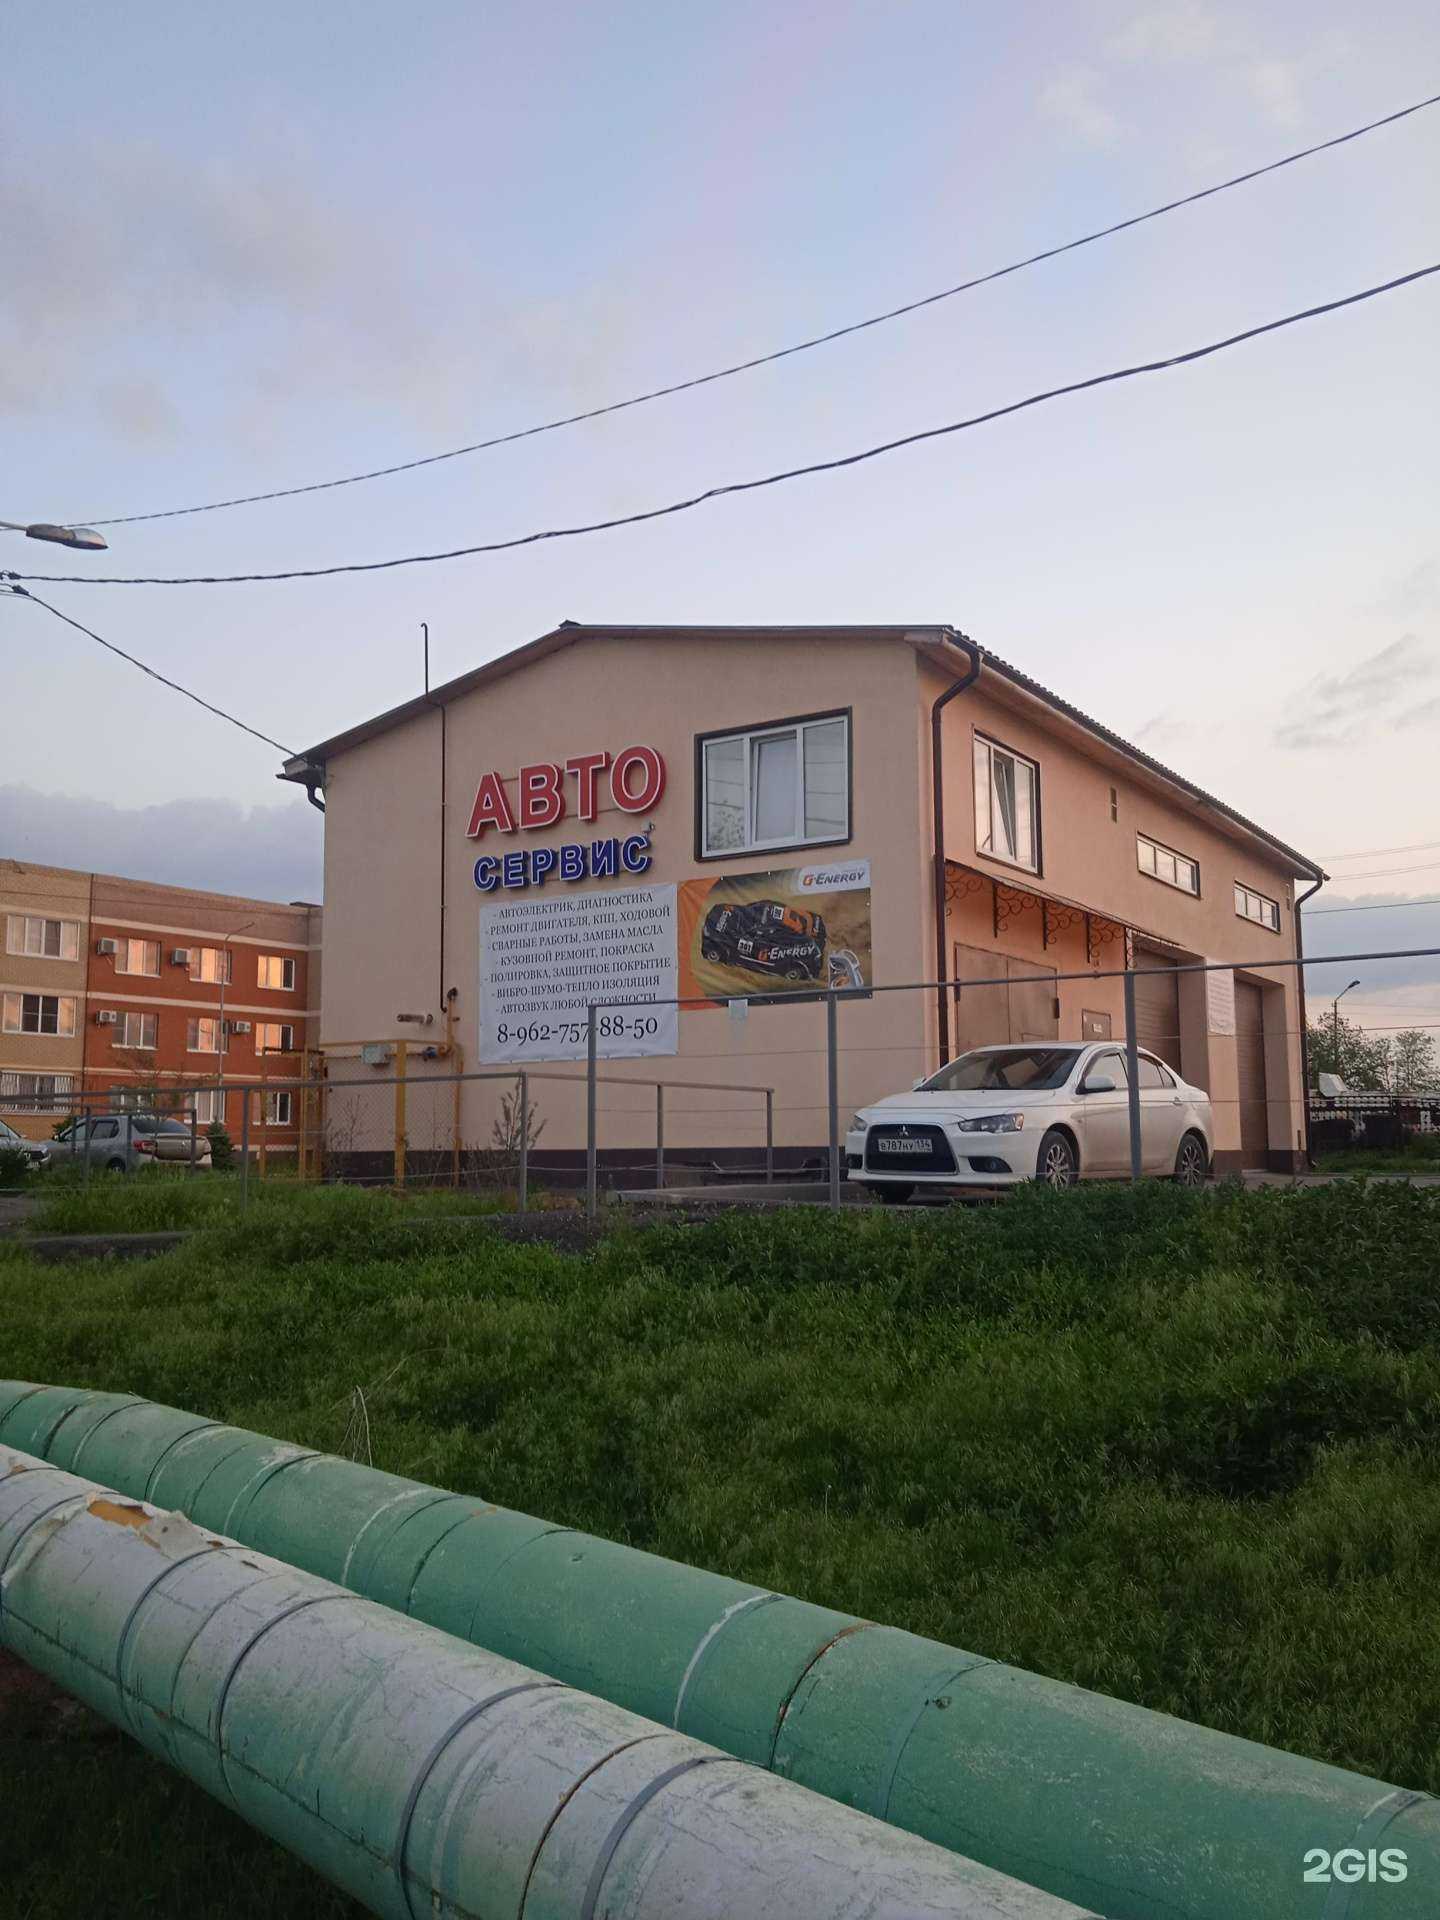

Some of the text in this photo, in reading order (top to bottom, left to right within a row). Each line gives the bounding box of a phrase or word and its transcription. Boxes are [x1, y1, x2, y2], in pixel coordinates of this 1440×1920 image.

[465, 745, 666, 839] АВТО
[473, 834, 652, 892] СЕРВИС
[499, 892, 653, 919] АВТОЭЛЕКТРИК, ДИАГНОСТИКА
[490, 923, 530, 936] РЕМОНТ
[531, 916, 591, 933] ДВИГАТЕЛЯ,
[620, 904, 670, 922] ХОДОВОЙ
[491, 923, 665, 951] СВАРНЫЕ РАБОТЫ, ЗАМЕНА МАСЛА
[500, 942, 655, 967] КУЗОВНОЙ РЕМОНТ, ПОКРАСКА
[490, 956, 671, 984] ПОЛИРОВКА, ЗАЩИТНОЕ ПОКРЫТИЕ
[602, 974, 660, 991] ИЗОЛЯЦИЯ
[500, 999, 549, 1015] АВТОЗВУК
[551, 994, 588, 1009] ЛЮБОЙ
